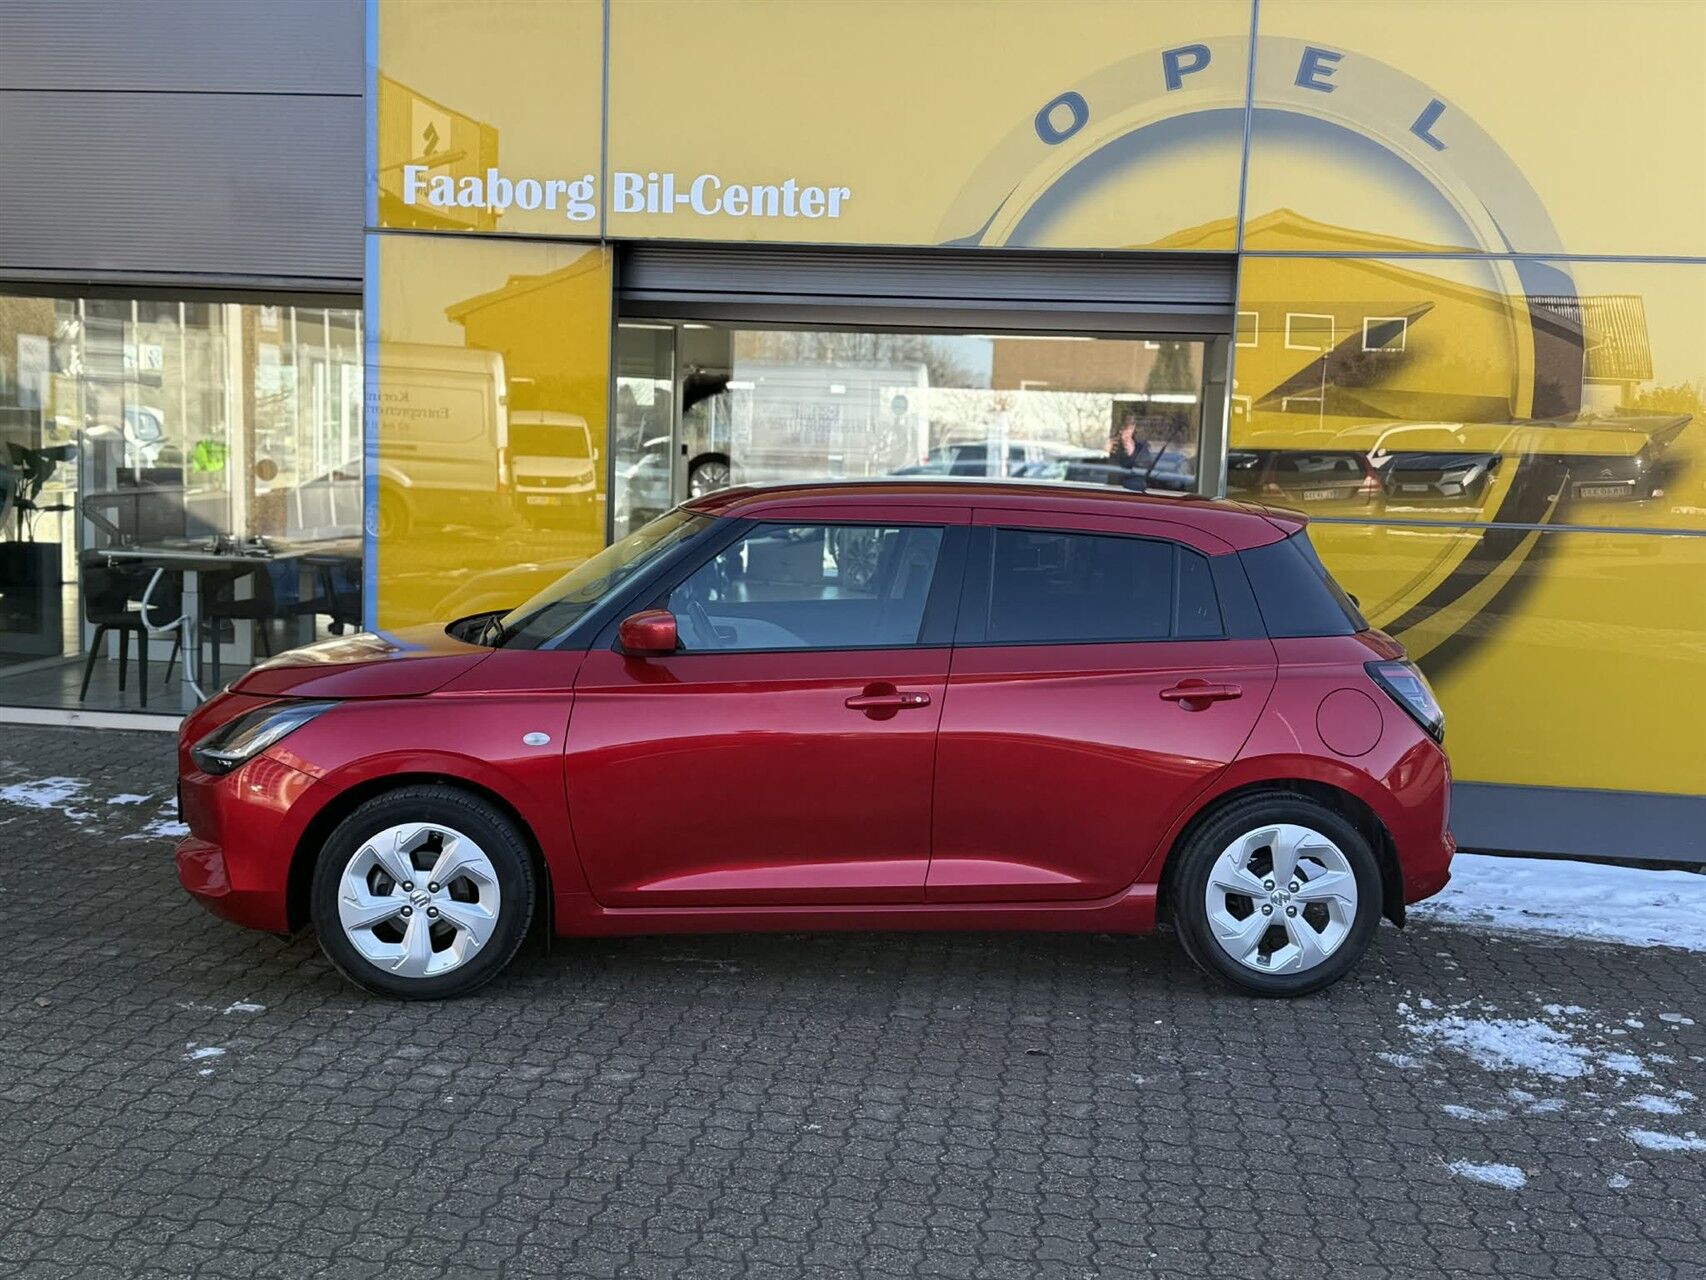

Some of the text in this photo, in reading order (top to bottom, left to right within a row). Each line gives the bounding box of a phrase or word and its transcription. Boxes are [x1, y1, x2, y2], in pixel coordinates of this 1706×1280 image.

[1034, 43, 1449, 152] OPEL
[402, 163, 597, 221] Faaborg
[613, 171, 851, 218] Bil-Center
